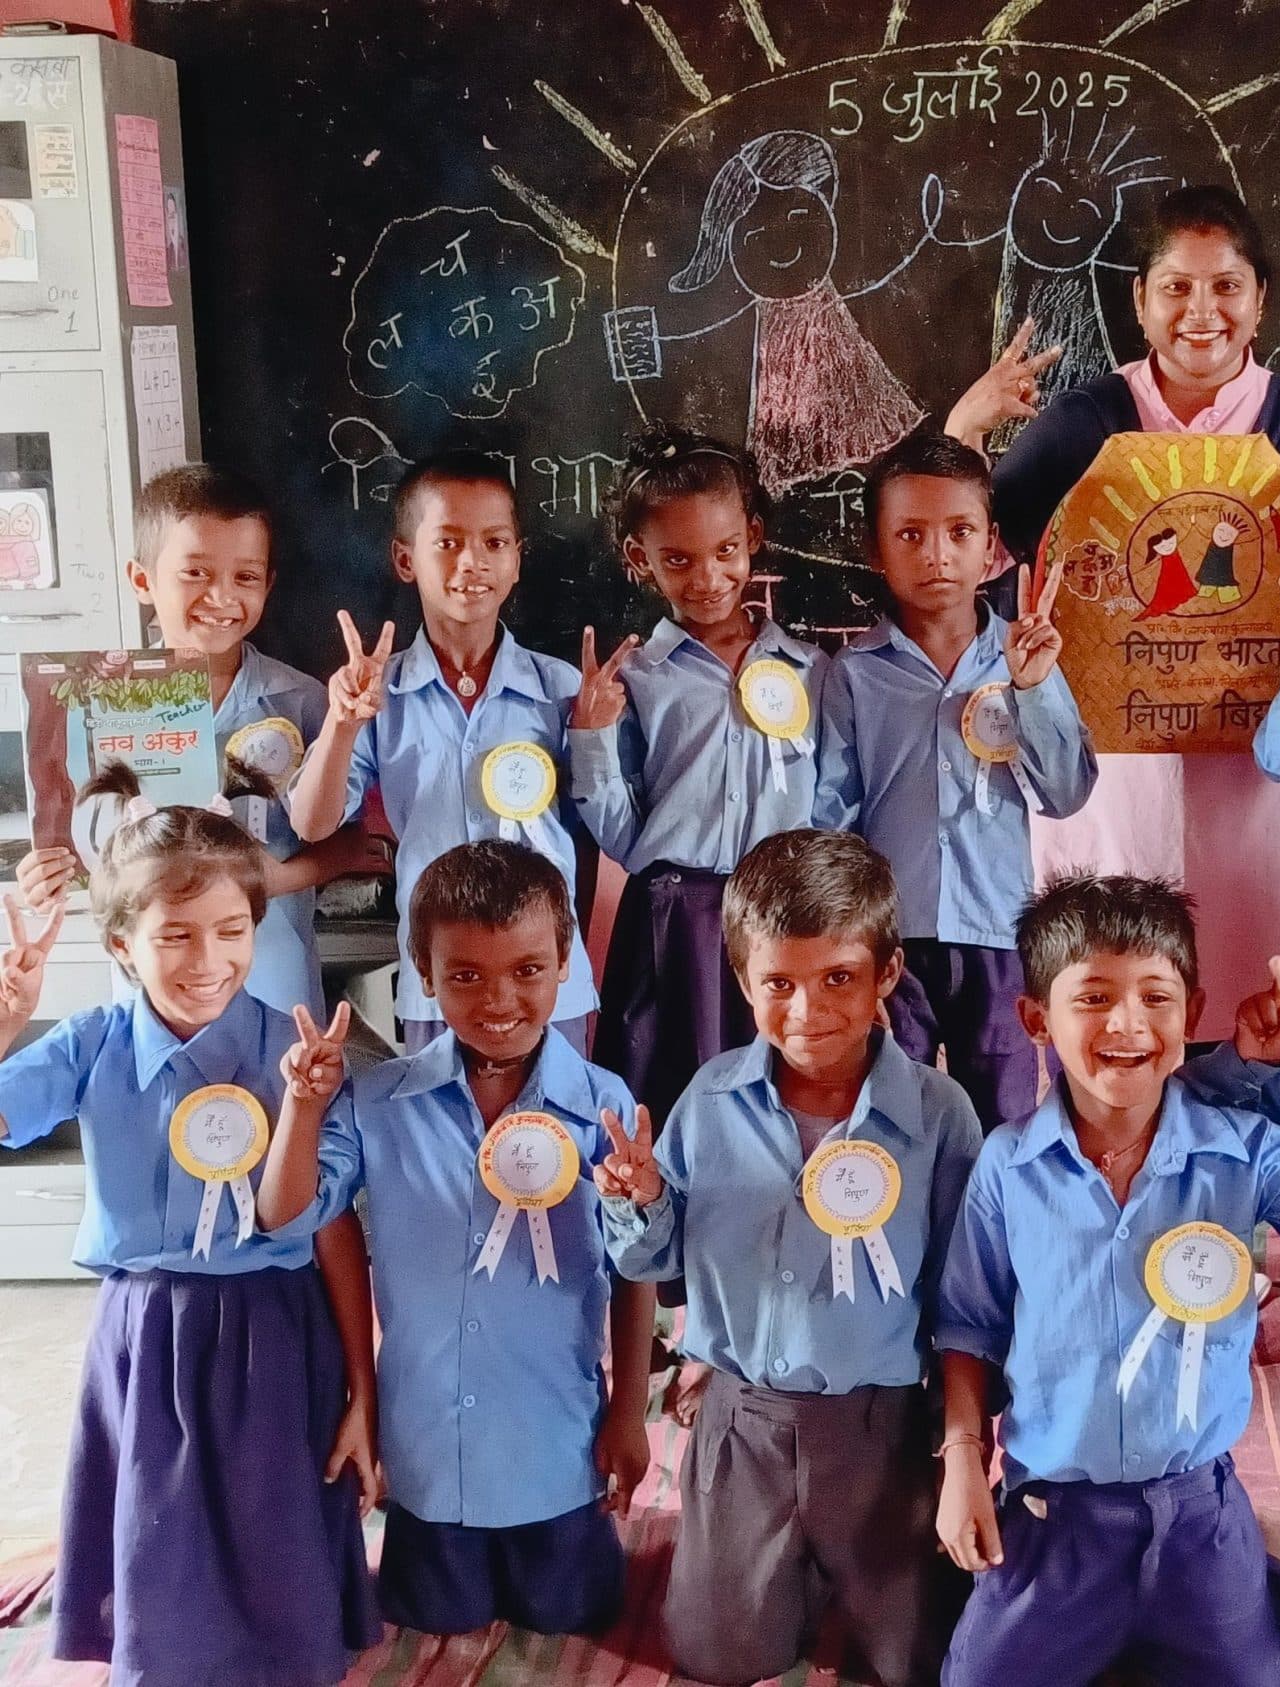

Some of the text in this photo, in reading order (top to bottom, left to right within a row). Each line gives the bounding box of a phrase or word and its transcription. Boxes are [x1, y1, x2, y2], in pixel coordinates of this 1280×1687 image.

[828, 45, 1131, 143] 5 जुलाई 2025
[448, 295, 494, 340] क
[510, 275, 561, 331] अ
[1114, 630, 1207, 675] निपुण
[155, 700, 209, 724] Teacher
[1116, 688, 1208, 741] निपुण
[97, 734, 134, 753] नव
[141, 726, 200, 756] अंकुर
[844, 1187, 870, 1203] निपुण
